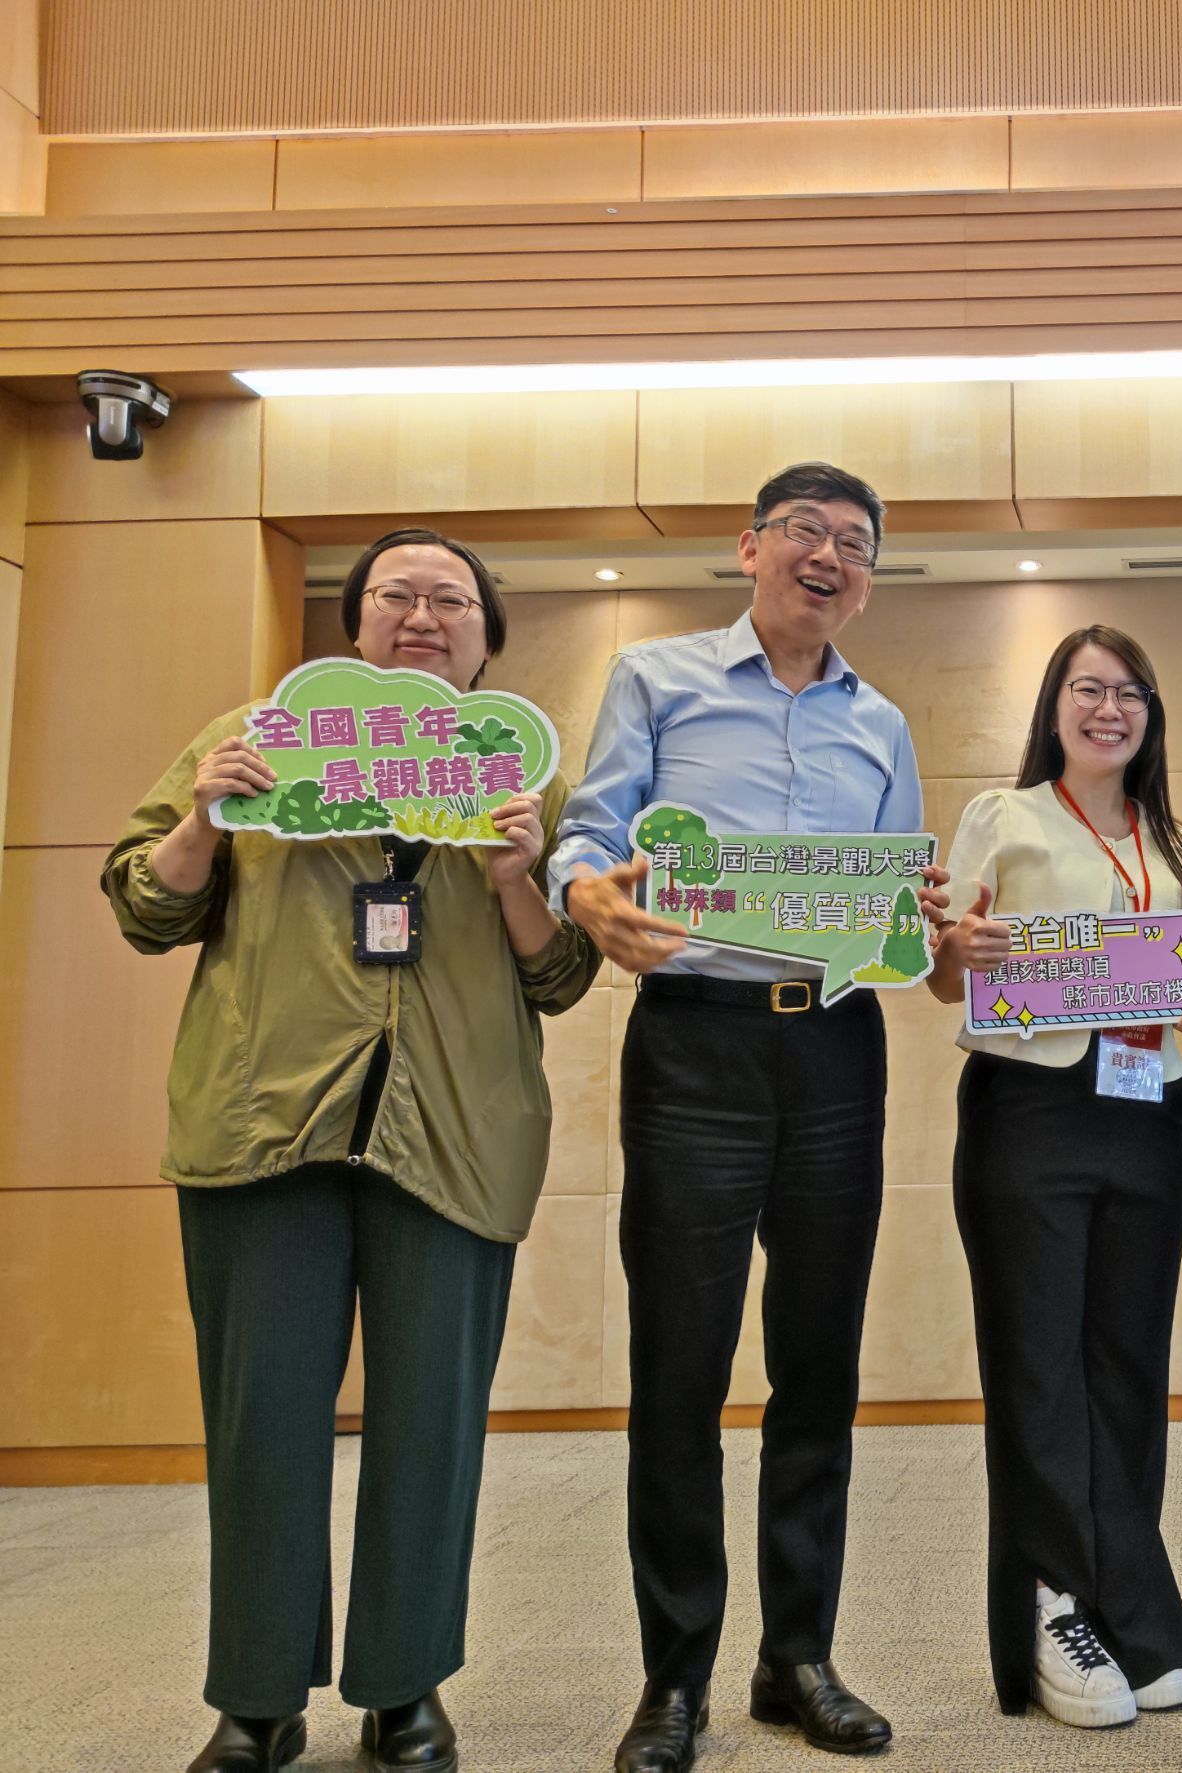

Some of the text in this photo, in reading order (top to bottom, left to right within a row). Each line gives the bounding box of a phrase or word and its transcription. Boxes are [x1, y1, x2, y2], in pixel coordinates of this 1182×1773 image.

[252, 704, 459, 750] 全國青年
[320, 754, 526, 803] 景觀競賽
[652, 841, 931, 877] 第13屆台灣景觀大獎
[656, 888, 737, 914] 特殊類
[985, 955, 1111, 986] 獲該類獎項
